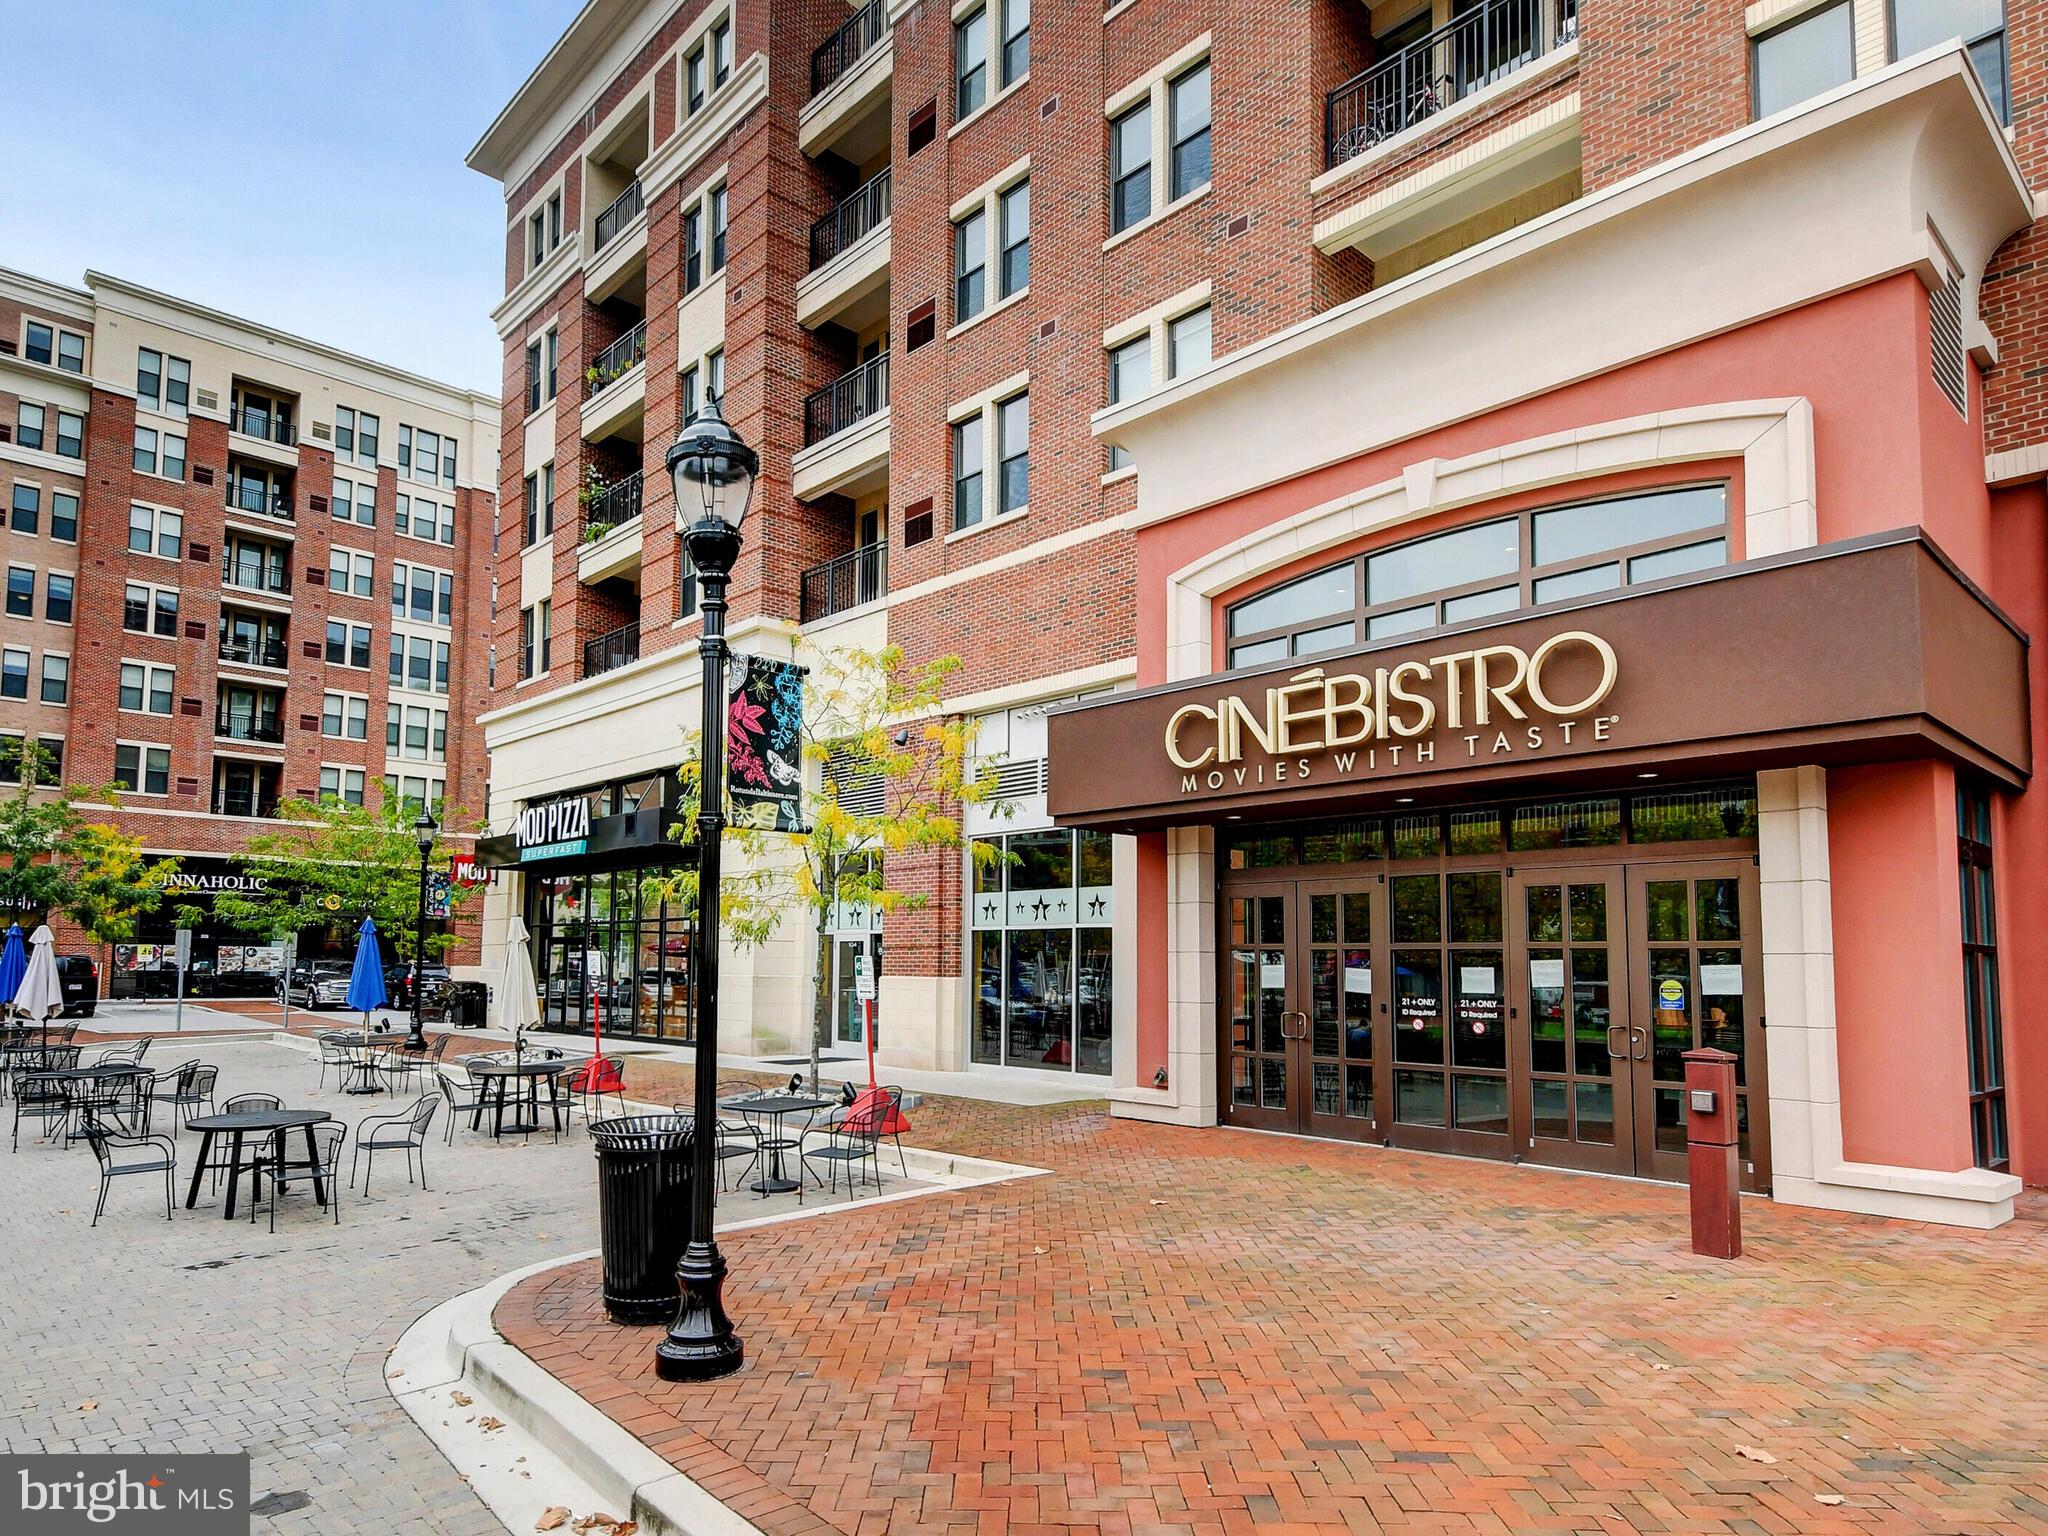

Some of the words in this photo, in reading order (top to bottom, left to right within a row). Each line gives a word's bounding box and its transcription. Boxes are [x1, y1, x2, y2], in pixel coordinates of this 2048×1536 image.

[1165, 631, 1618, 769] CINÉBISTRO
[1181, 758, 1311, 793] MOVIES
[1335, 741, 1435, 774] WITH
[730, 785, 798, 800] RotundaBaltimore.com
[516, 807, 546, 848] MOD
[548, 797, 589, 842] PIZZA
[525, 843, 578, 859] SUPERFAST
[1469, 1011, 1497, 1019] Required
